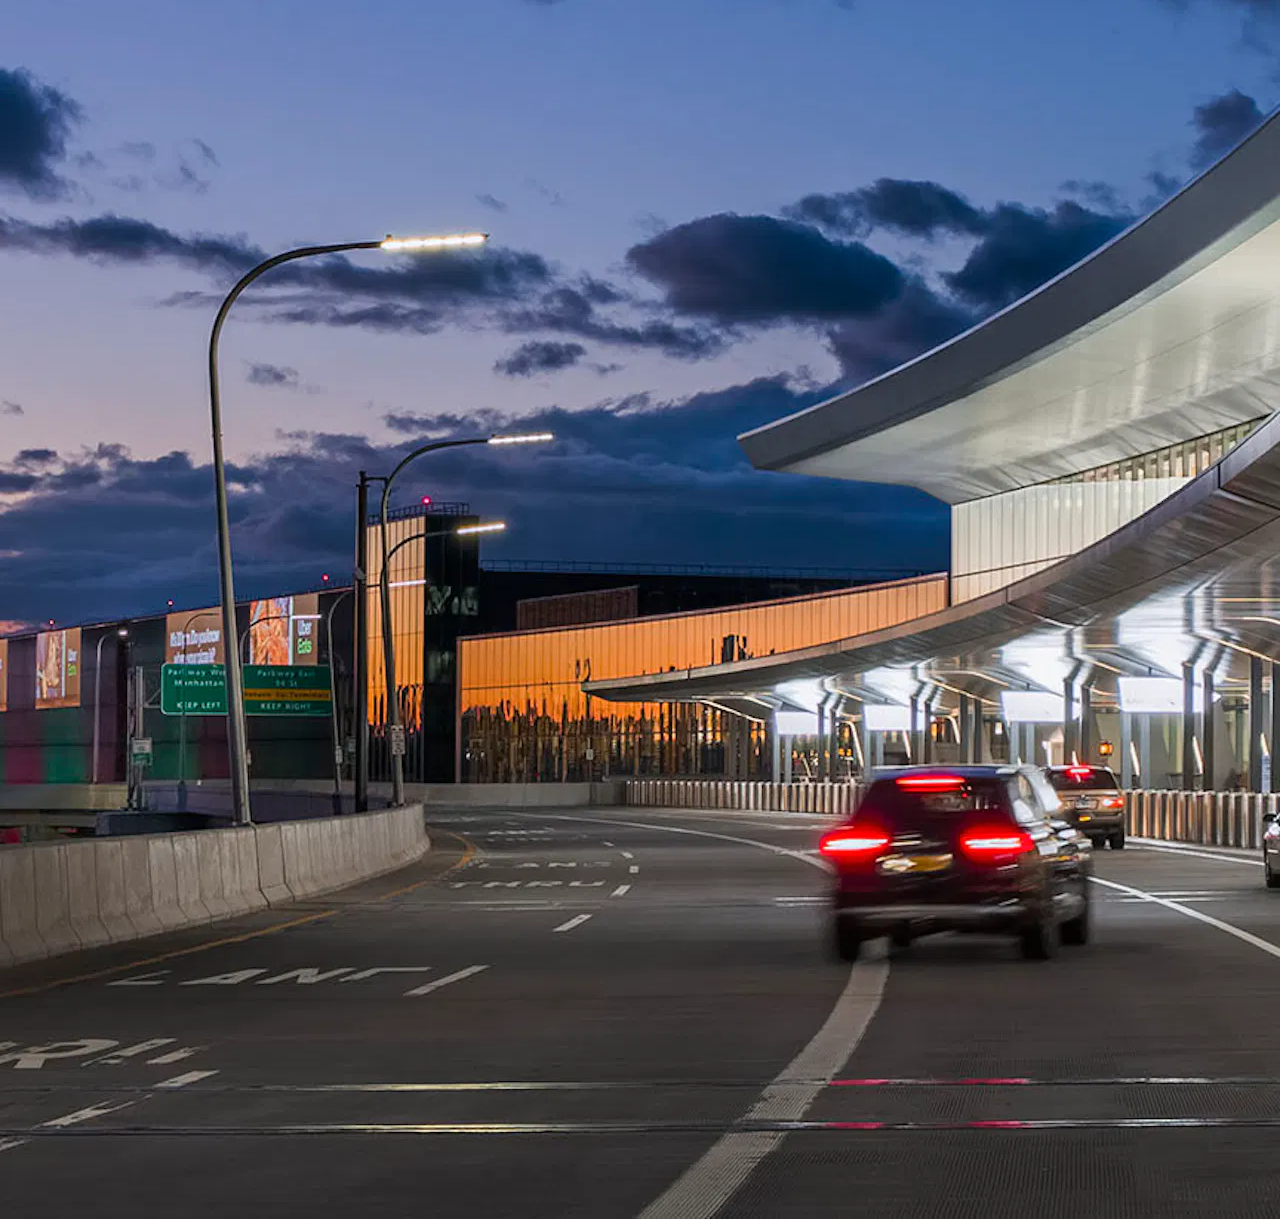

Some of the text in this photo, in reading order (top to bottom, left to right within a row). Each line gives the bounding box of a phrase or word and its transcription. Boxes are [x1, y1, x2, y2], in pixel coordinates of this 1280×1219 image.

[201, 701, 221, 709] LEFT
[260, 702, 312, 710] KEEP RIGHT
